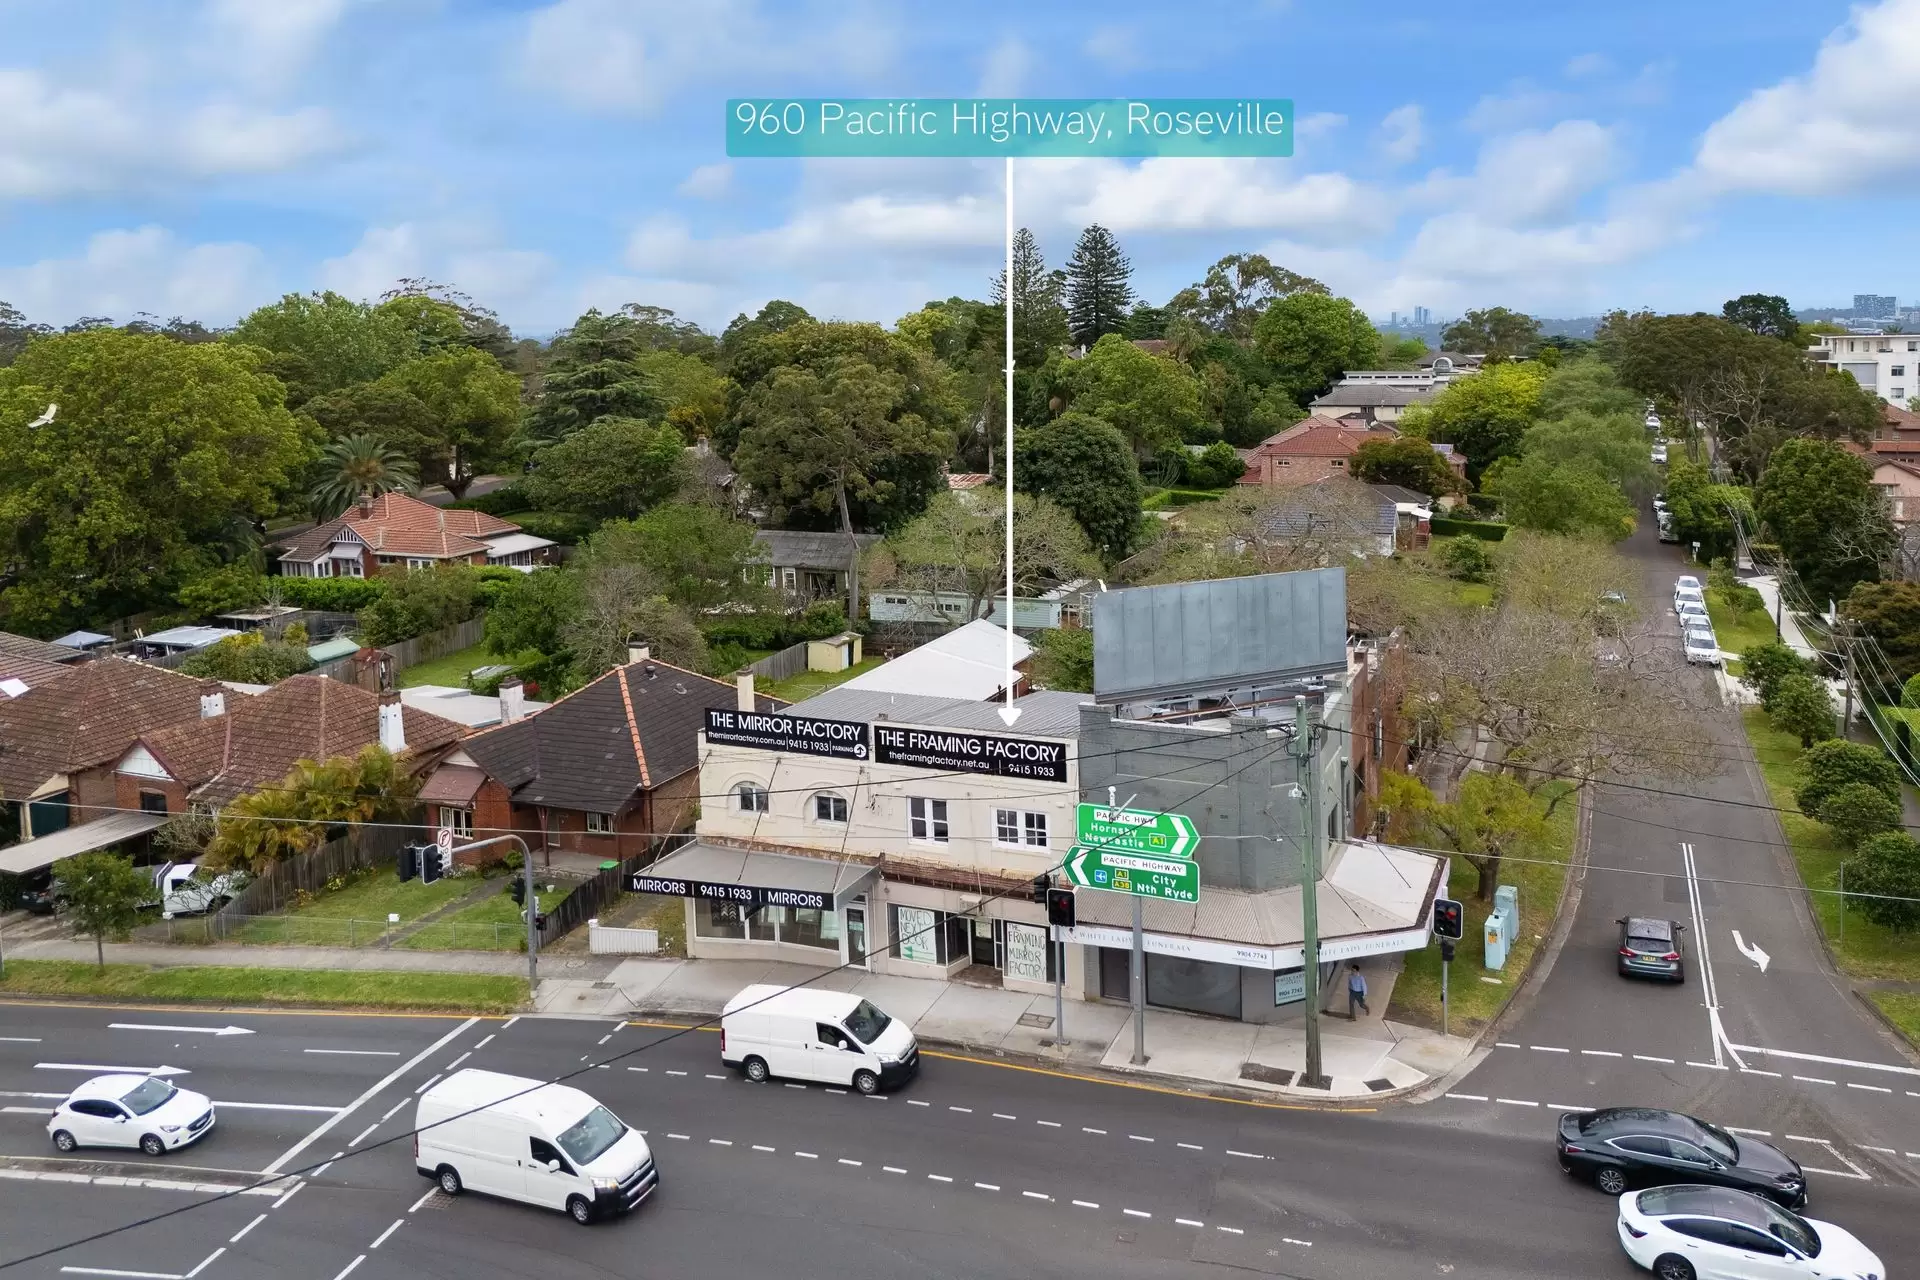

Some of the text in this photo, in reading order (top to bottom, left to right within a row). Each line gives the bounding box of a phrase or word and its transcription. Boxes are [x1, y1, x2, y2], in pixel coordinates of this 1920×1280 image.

[711, 711, 862, 741] THE MIRROR FACTORY
[708, 731, 854, 753] themirrorfactory.com.au 9415 1933 PARKING
[879, 729, 1060, 763] THE FRAMING FACTORY
[889, 751, 1055, 777] theframingfactory.net.au 9415 1933
[1134, 816, 1155, 825] HWY
[1091, 822, 1138, 838] Hornsby
[1085, 832, 1164, 848] Newcastle A1
[1103, 856, 1183, 873] PACIFIC HIGHWAY
[1117, 870, 1177, 888] A1 City
[633, 878, 823, 907] MIRRORS 9415 1933 MIRRORS
[1136, 882, 1157, 895] Nth
[1164, 887, 1193, 899] Ryde
[900, 908, 933, 925] MOVED
[1008, 930, 1046, 950] FRAMING
[1009, 947, 1042, 965] MIRROR
[1009, 960, 1046, 980] FACTORY
